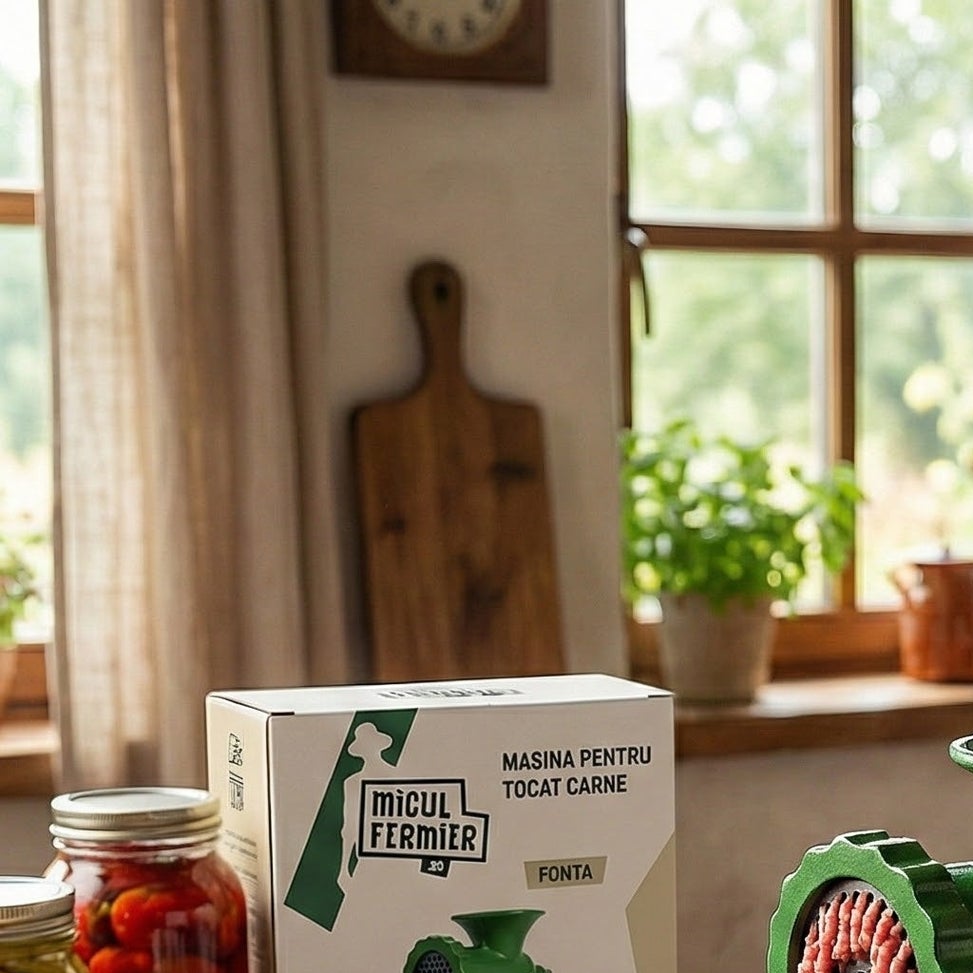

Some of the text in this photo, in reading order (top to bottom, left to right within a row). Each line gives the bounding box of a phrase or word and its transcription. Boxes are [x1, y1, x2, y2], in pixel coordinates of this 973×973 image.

[502, 746, 651, 772] MASINA PENTRU
[502, 774, 627, 799] TOCAT CARNE
[538, 863, 593, 883] FONTA
